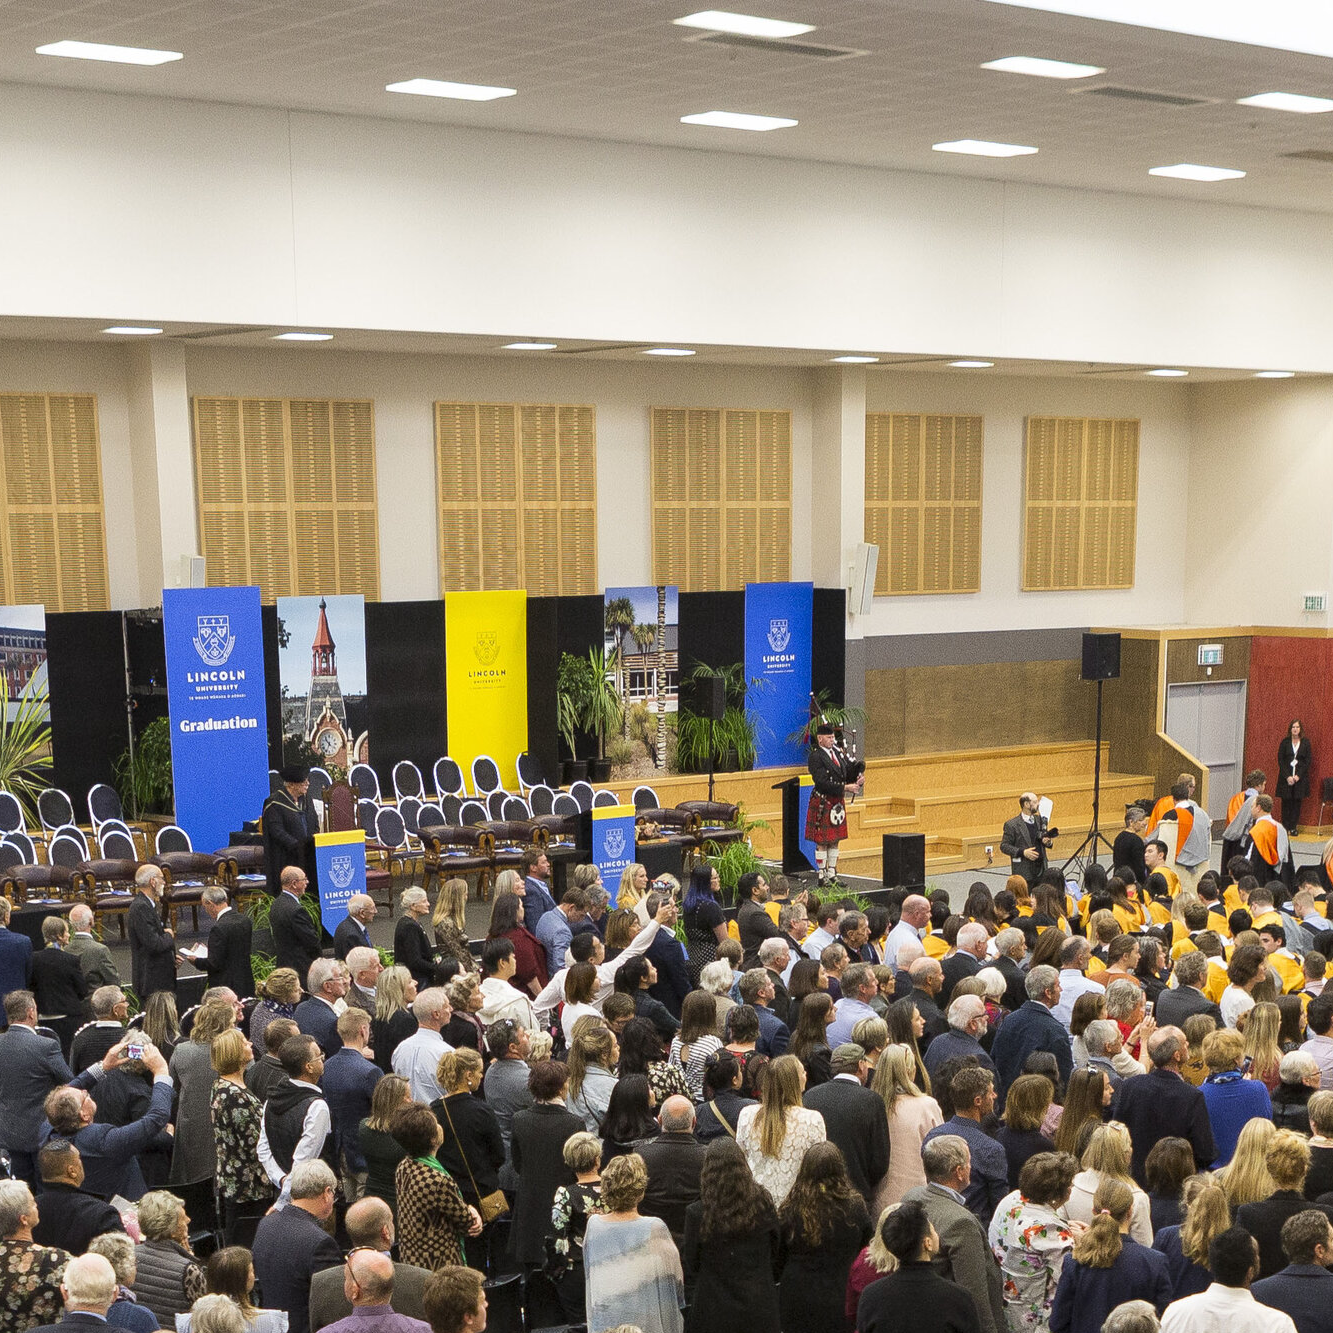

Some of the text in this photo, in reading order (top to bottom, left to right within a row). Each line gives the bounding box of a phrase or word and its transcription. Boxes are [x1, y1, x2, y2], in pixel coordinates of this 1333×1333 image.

[762, 654, 796, 663] LINCOLN
[187, 669, 246, 683] LINCOLN
[468, 669, 506, 678] LINCOLN
[195, 684, 239, 692] UNIVERSITY
[179, 715, 258, 733] Graduation
[599, 859, 631, 869] LINCOLN
[324, 888, 361, 900] LINCOLN
